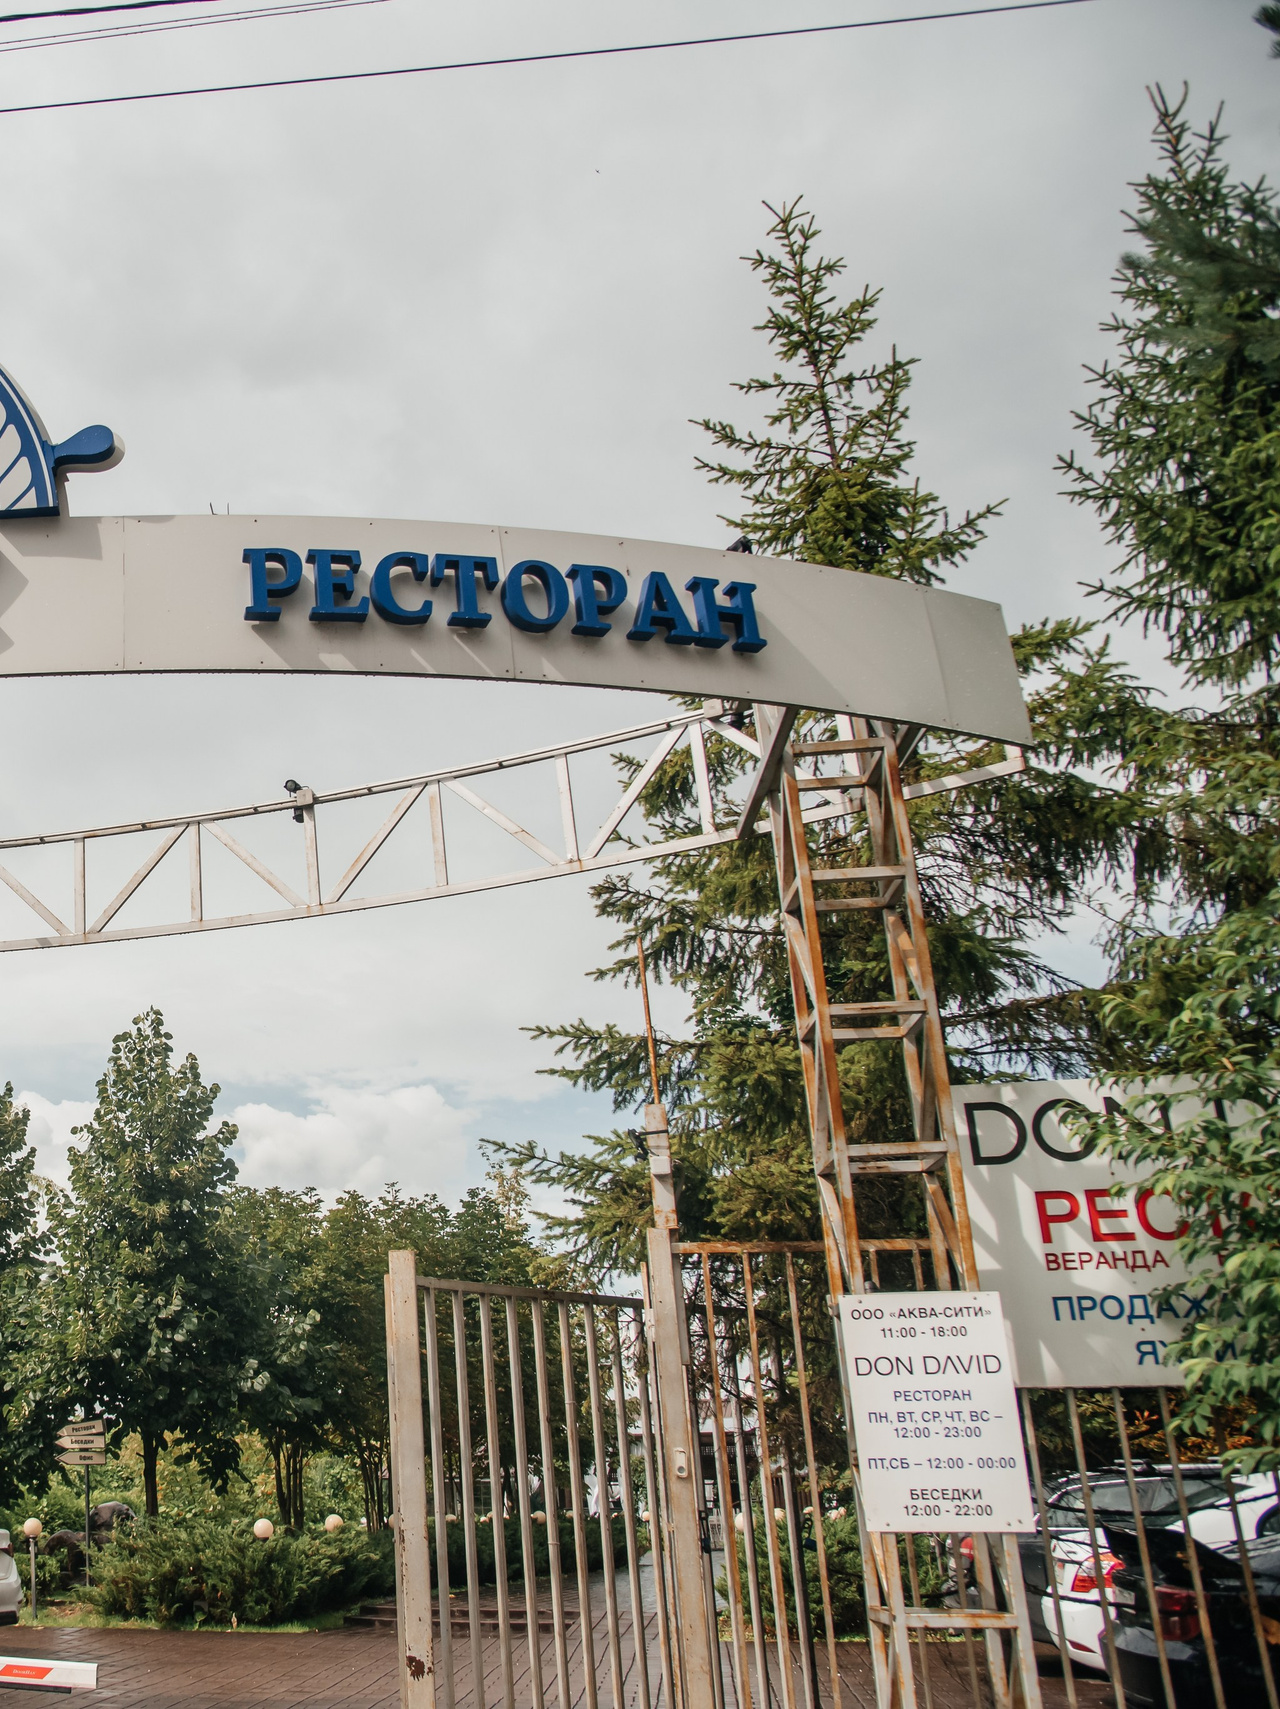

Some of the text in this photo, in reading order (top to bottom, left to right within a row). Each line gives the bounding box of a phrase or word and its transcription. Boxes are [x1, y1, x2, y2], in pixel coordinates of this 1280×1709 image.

[242, 548, 768, 653] РЕСТОРАН
[1045, 1250, 1170, 1272] ВЕРАНДА
[851, 1306, 992, 1320] ООО «АКВА-СИТИ»
[1051, 1293, 1243, 1325] ПРОДАЖ
[880, 1327, 917, 1338] 11:00
[930, 1326, 967, 1338] 18:00
[854, 1354, 1002, 1376] DON DAVID
[893, 1389, 972, 1402] РЕСТОРАН
[868, 1412, 893, 1424] ПН,
[897, 1411, 918, 1424] ВТ,
[970, 1410, 990, 1422] ВС
[894, 1427, 931, 1438] 12:00
[943, 1426, 982, 1438] 23:00
[868, 1458, 910, 1471] ПТ,СБ
[927, 1457, 964, 1469] 12:00
[977, 1457, 1016, 1469] 00:00
[909, 1489, 982, 1502] БЕСЕДКИ
[903, 1505, 941, 1516] 12:00
[954, 1504, 993, 1516] 22:00
